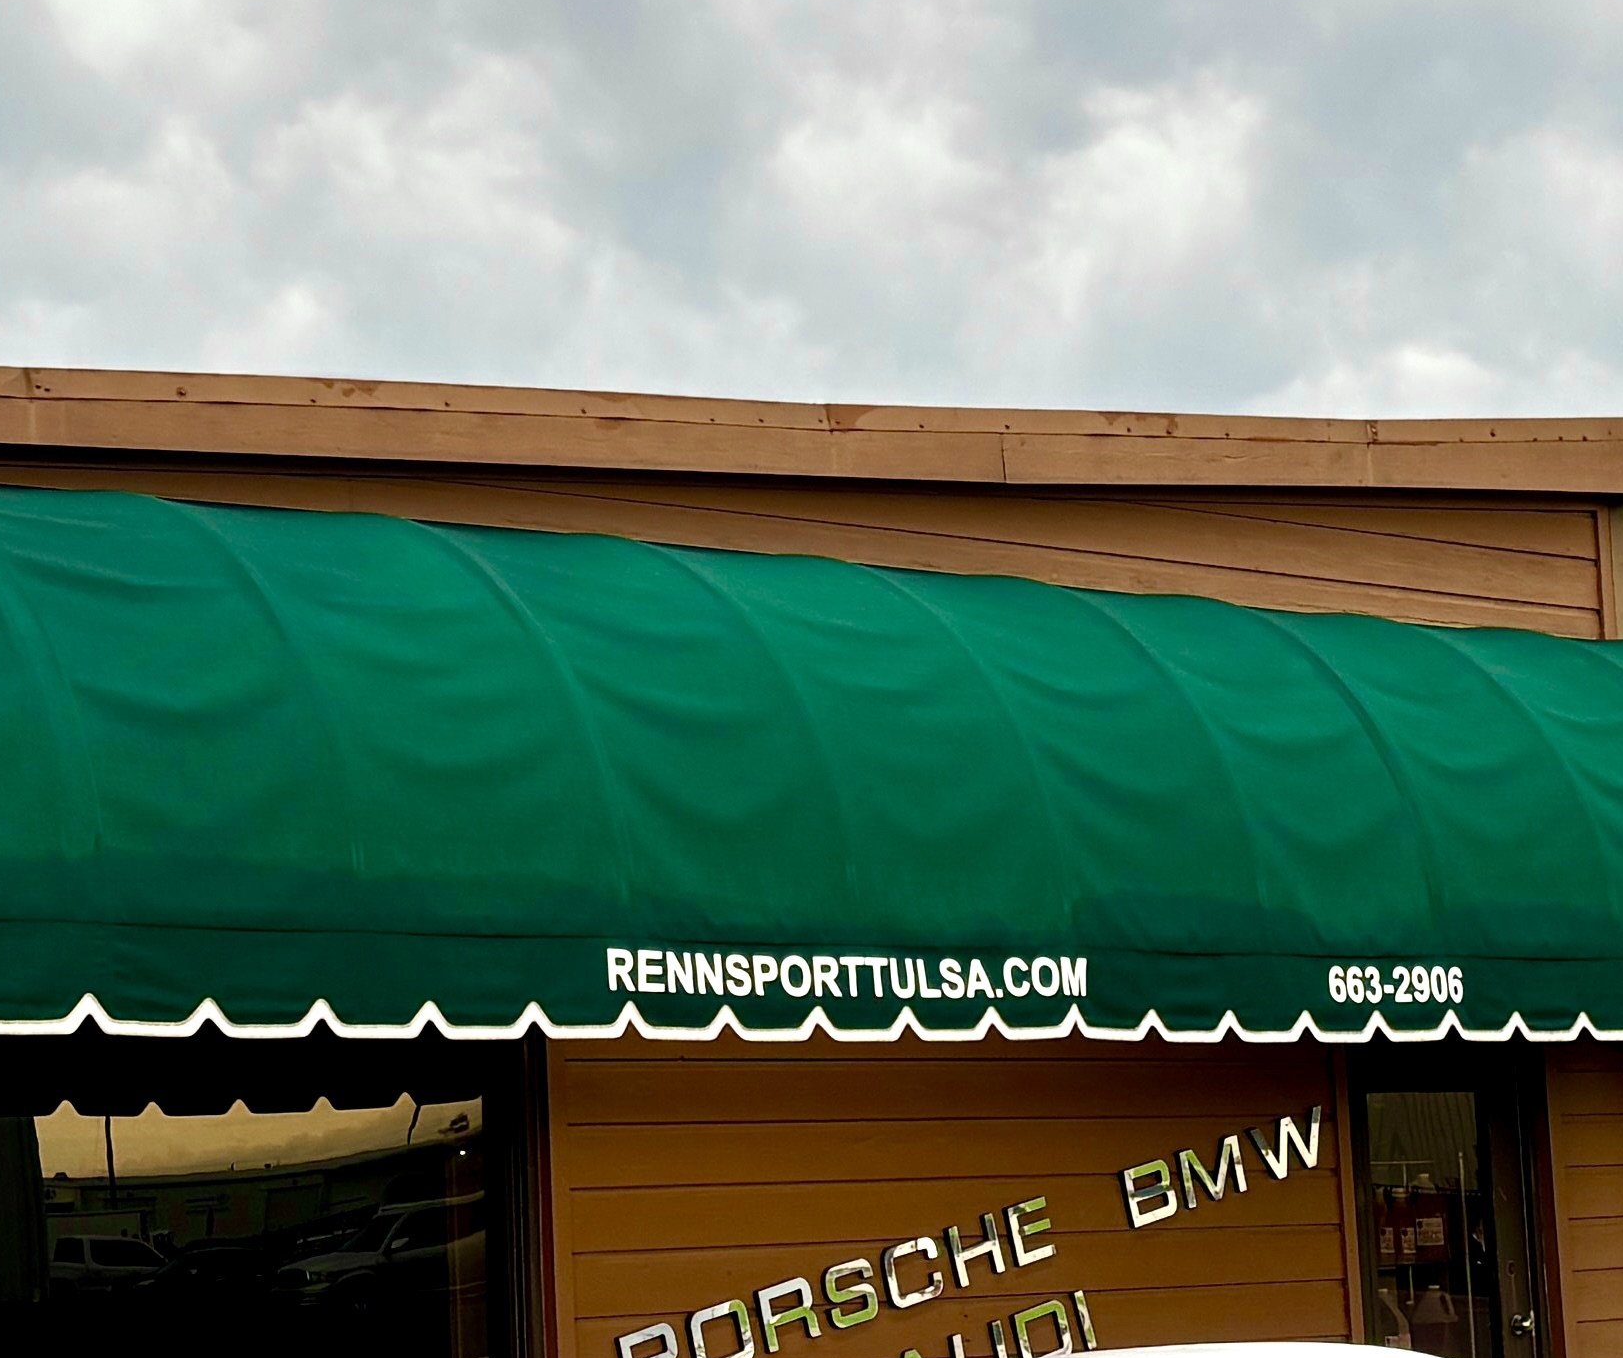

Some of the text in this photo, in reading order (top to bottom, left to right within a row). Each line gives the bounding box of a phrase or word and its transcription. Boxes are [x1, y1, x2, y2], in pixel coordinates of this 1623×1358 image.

[606, 948, 1464, 1005] RENNSPORTTULSA.COM 663-2906
[1120, 1105, 1324, 1229] BMW
